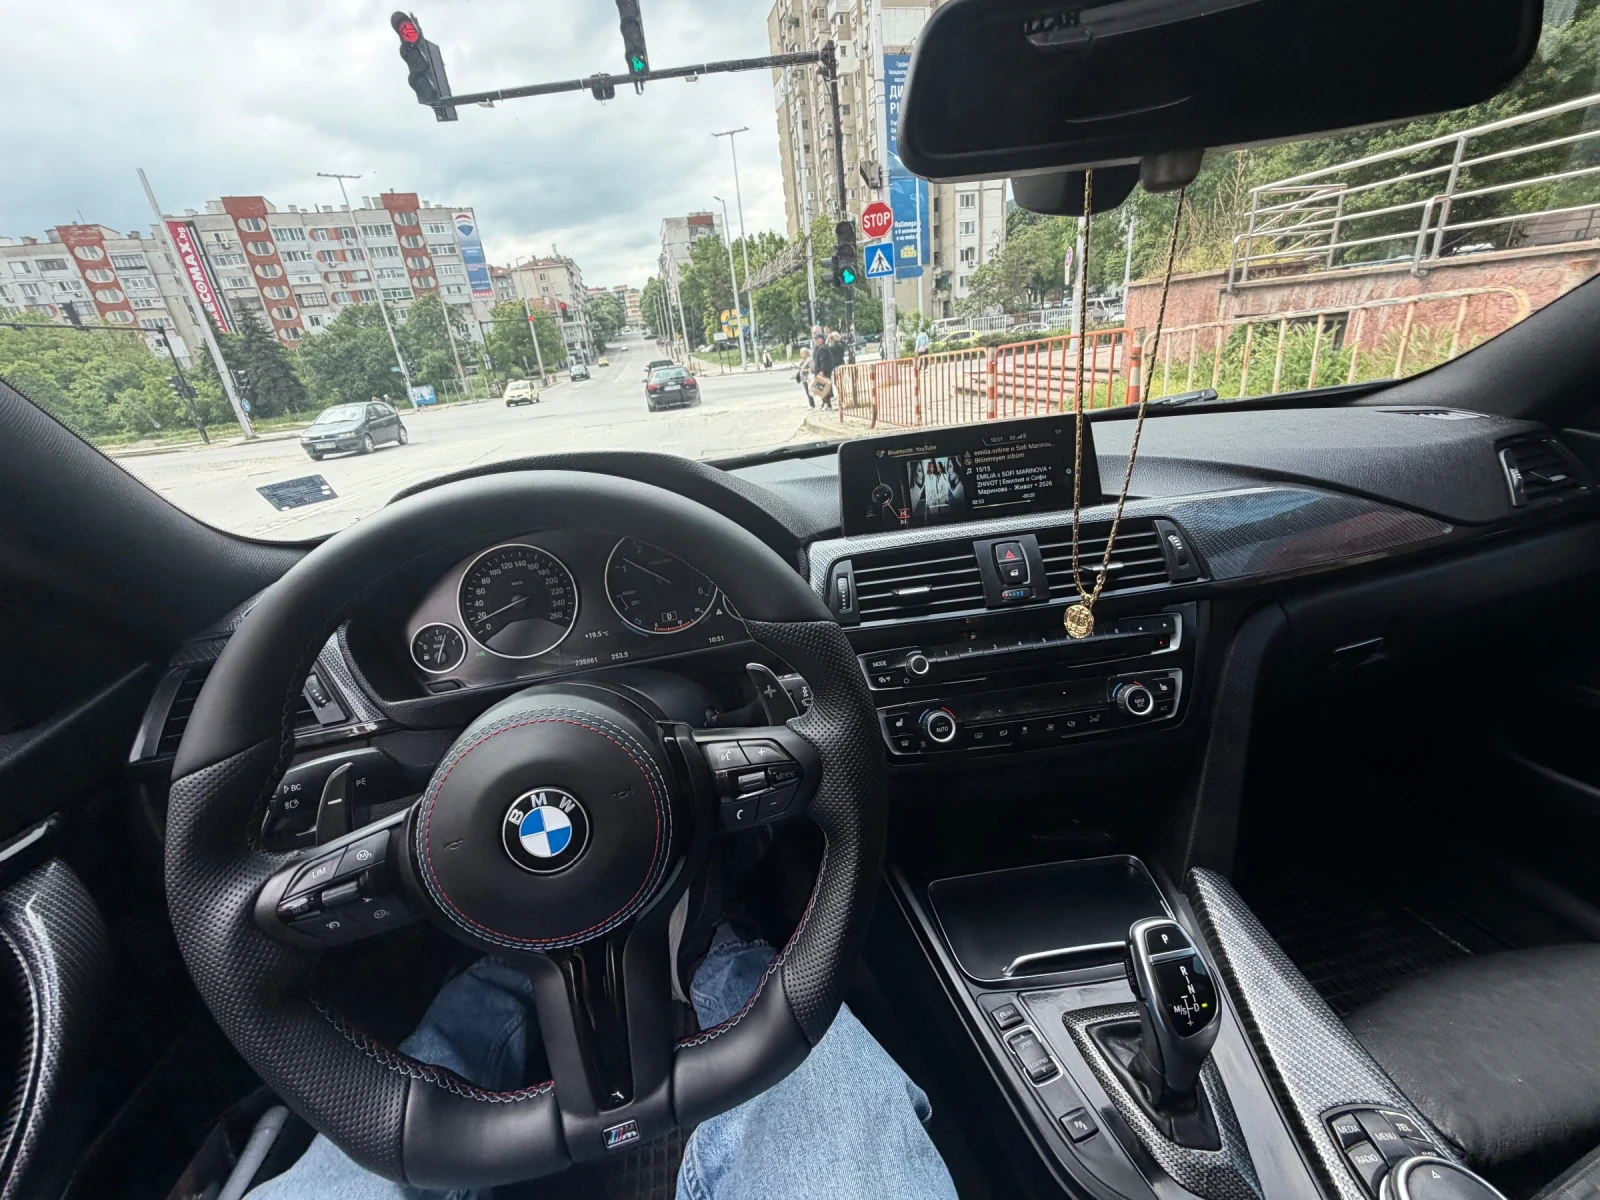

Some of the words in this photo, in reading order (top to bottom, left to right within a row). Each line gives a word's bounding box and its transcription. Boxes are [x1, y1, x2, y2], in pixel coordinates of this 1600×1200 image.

[864, 211, 891, 229] STOP
[1015, 443, 1027, 451] Sofi
[974, 454, 1006, 464] Bilinmeyen
[976, 465, 991, 473] 15/15
[976, 472, 996, 481] EMILIA
[1001, 469, 1015, 477] SOFI
[1016, 466, 1048, 475] MARINOVA
[976, 479, 999, 488] ZHIVOT
[1002, 476, 1025, 485] Емилия
[1031, 474, 1047, 482] Софи
[977, 486, 1008, 495] Маринова
[1014, 483, 1034, 491] Живот
[527, 562, 539, 570] 160
[489, 568, 501, 576] 100
[538, 568, 550, 576] 180
[545, 577, 558, 585] 200
[552, 599, 565, 607] 240
[477, 611, 486, 619] 20
[550, 611, 563, 619] 260
[584, 631, 602, 639] +19.5
[708, 636, 725, 644] 10:51
[611, 652, 629, 660] 253.5
[872, 660, 887, 668] MODE
[775, 770, 795, 781] MODE
[291, 783, 302, 791] BC
[508, 792, 576, 826] BMW
[311, 866, 327, 878] LIM
[1161, 933, 1169, 944] P
[1180, 965, 1188, 976] R
[1187, 984, 1196, 994] N
[1193, 1003, 1200, 1012] D
[1337, 1124, 1361, 1134] MEDIA
[1396, 1123, 1413, 1133] TEL
[1374, 1132, 1397, 1141] MENU
[1355, 1153, 1379, 1164] RADIO
